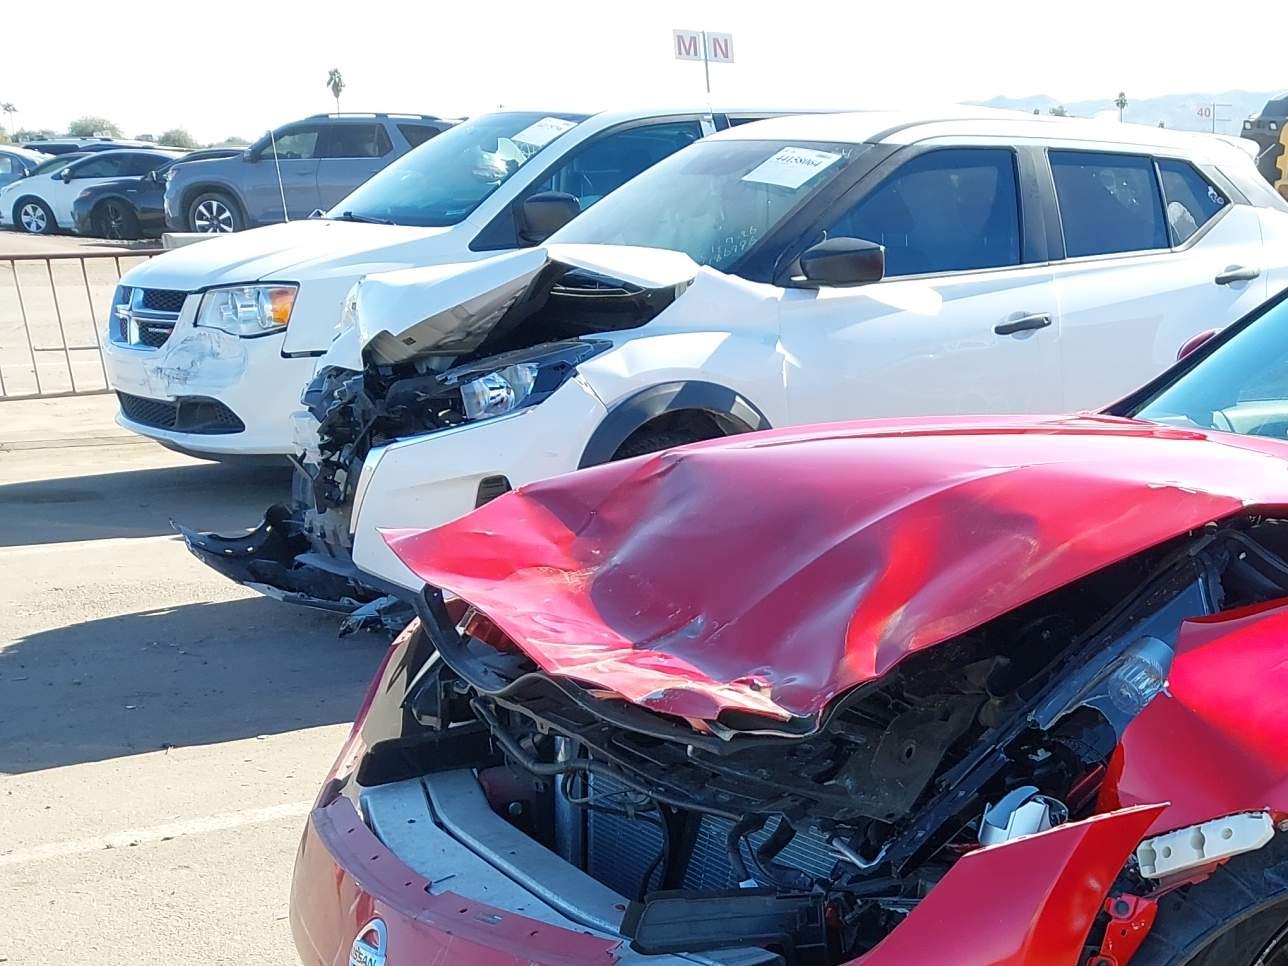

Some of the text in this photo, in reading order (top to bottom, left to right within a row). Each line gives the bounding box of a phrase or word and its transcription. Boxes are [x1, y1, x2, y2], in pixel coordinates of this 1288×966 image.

[676, 34, 729, 59] M N
[1196, 107, 1211, 118] 40
